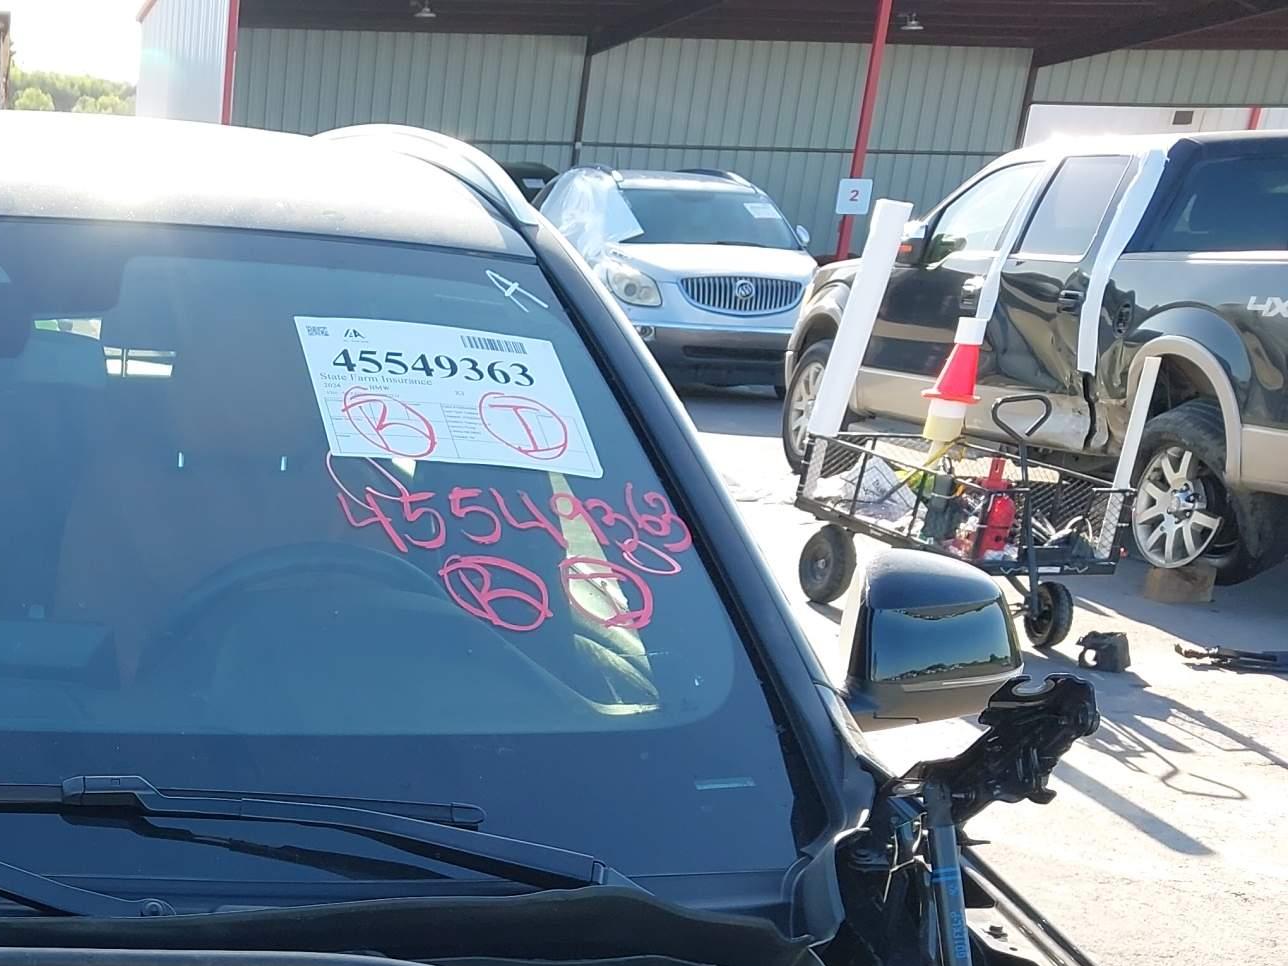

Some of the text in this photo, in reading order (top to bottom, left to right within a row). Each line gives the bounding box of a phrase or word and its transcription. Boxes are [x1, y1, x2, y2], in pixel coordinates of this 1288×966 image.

[849, 189, 860, 202] 2
[332, 348, 535, 387] 45549363
[319, 372, 433, 386] State Farm Insurance
